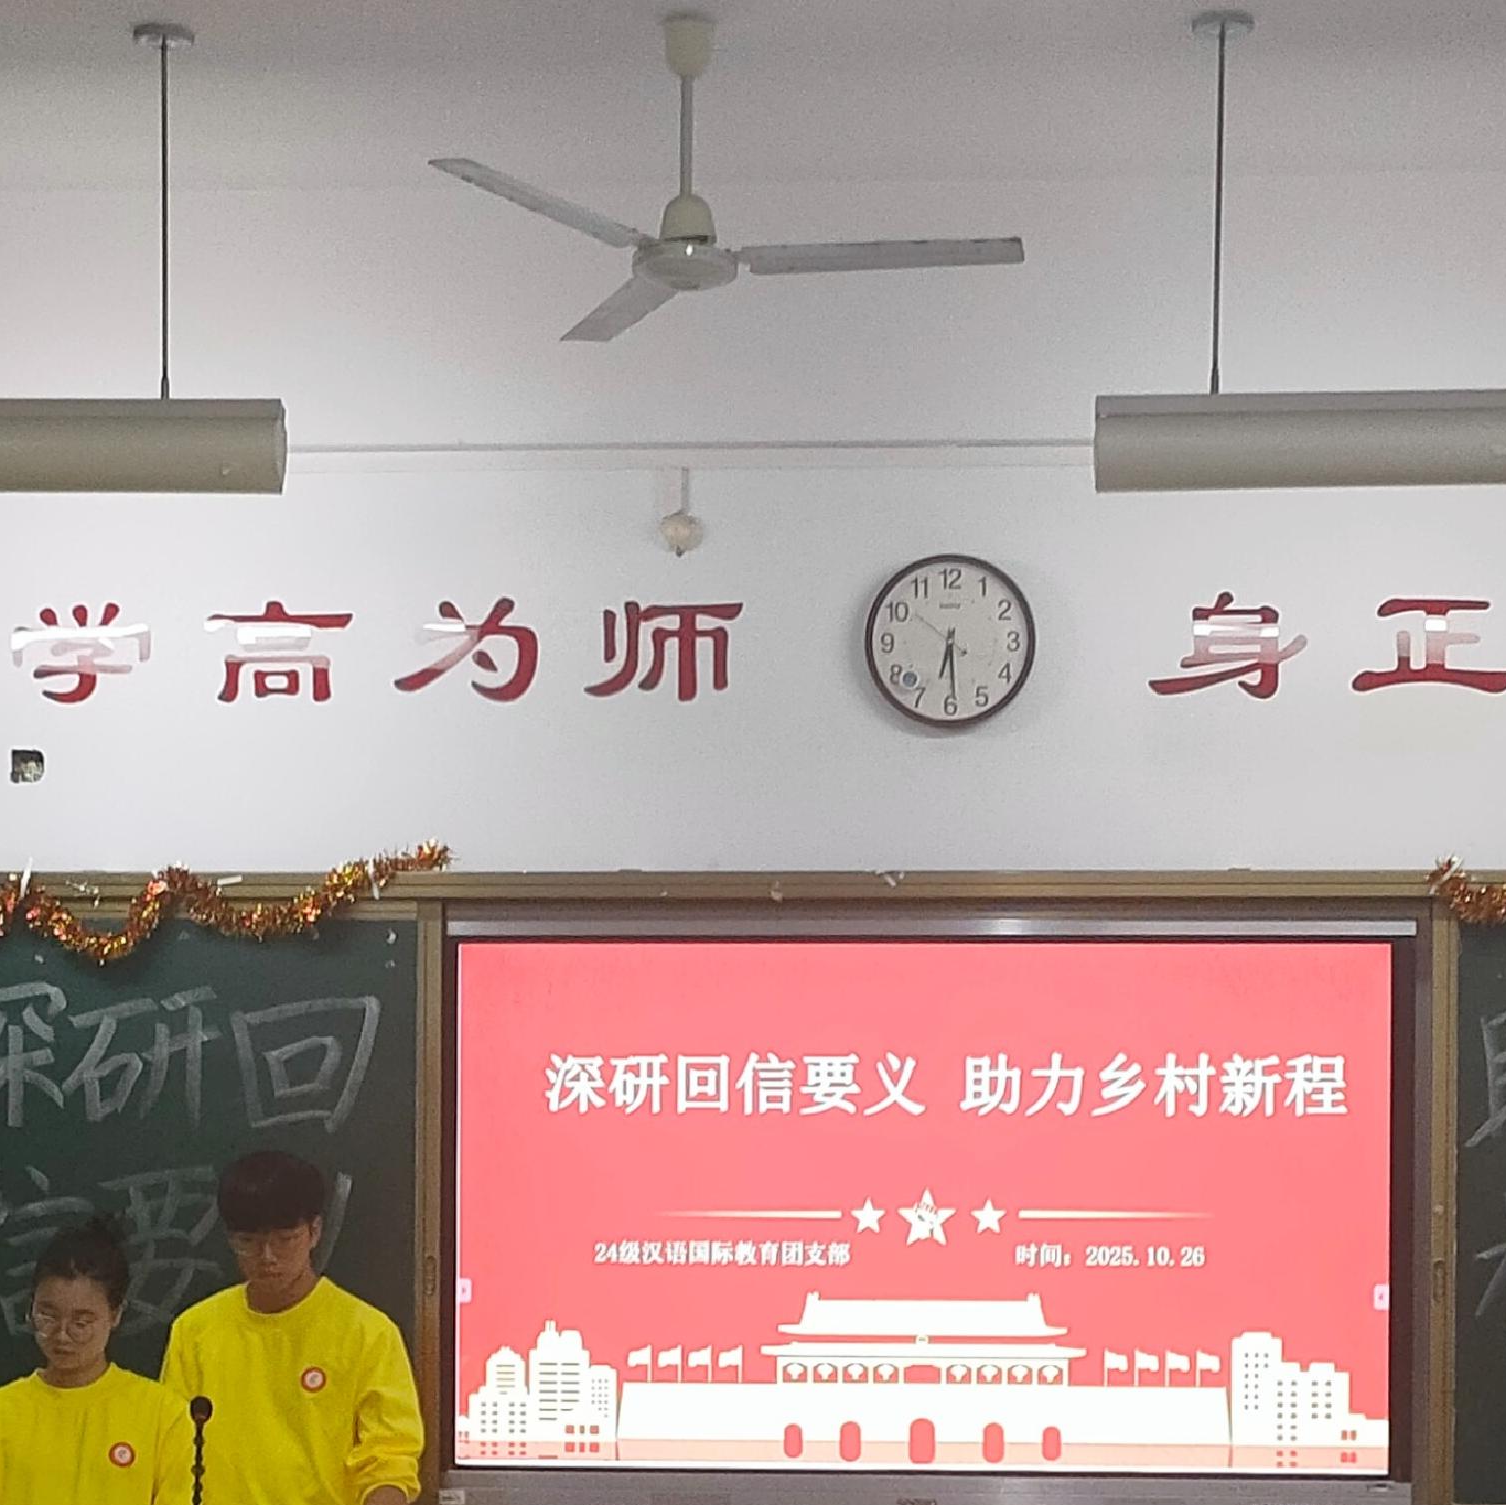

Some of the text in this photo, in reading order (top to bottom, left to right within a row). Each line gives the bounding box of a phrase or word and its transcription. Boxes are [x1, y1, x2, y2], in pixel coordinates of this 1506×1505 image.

[911, 576, 928, 599] 11
[938, 568, 962, 590] 12
[978, 576, 987, 597] 1
[885, 601, 909, 623] 10
[998, 599, 1012, 621] 2
[11, 597, 744, 703] 学高为师
[880, 632, 895, 654] 9
[1006, 631, 1020, 652] 3
[889, 664, 903, 685] 8
[998, 663, 1012, 684] 4
[912, 687, 926, 708] 7
[944, 695, 958, 717] 6
[975, 686, 989, 707] 5
[543, 1050, 1349, 1120] 深研回信要义 助力乡村新程
[593, 1238, 851, 1268] 24级汉语国际教育团支部
